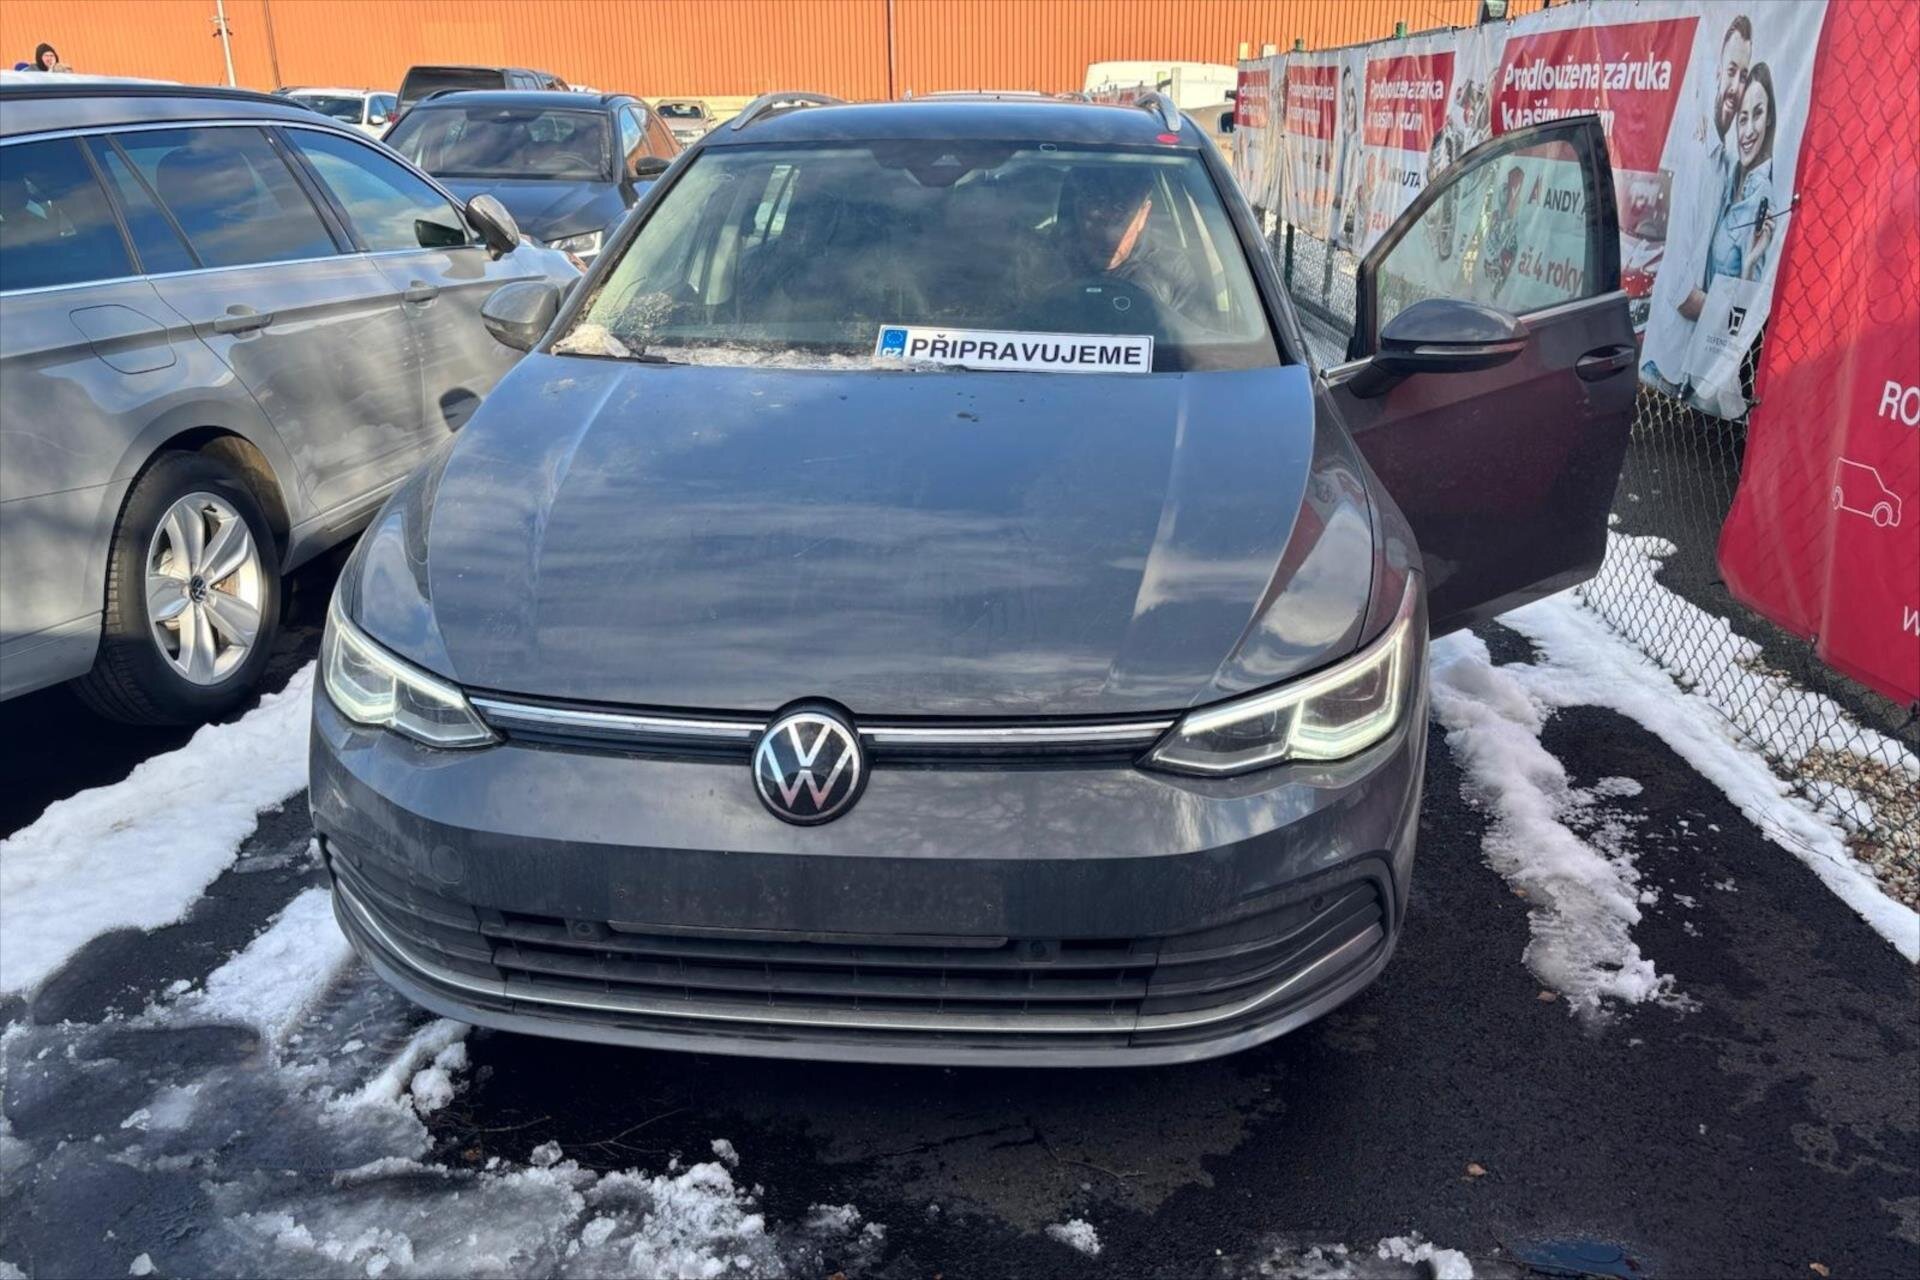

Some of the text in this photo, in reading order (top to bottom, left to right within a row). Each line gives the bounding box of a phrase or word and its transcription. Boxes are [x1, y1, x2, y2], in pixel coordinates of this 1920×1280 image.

[1502, 52, 1672, 92] Prodloužená záruka
[1501, 100, 1514, 131] k
[1543, 188, 1581, 214] ANDY
[1518, 245, 1585, 298] až 4 roky
[910, 334, 1142, 365] PŘIPRAVUJEME
[1878, 380, 1920, 426] RO
